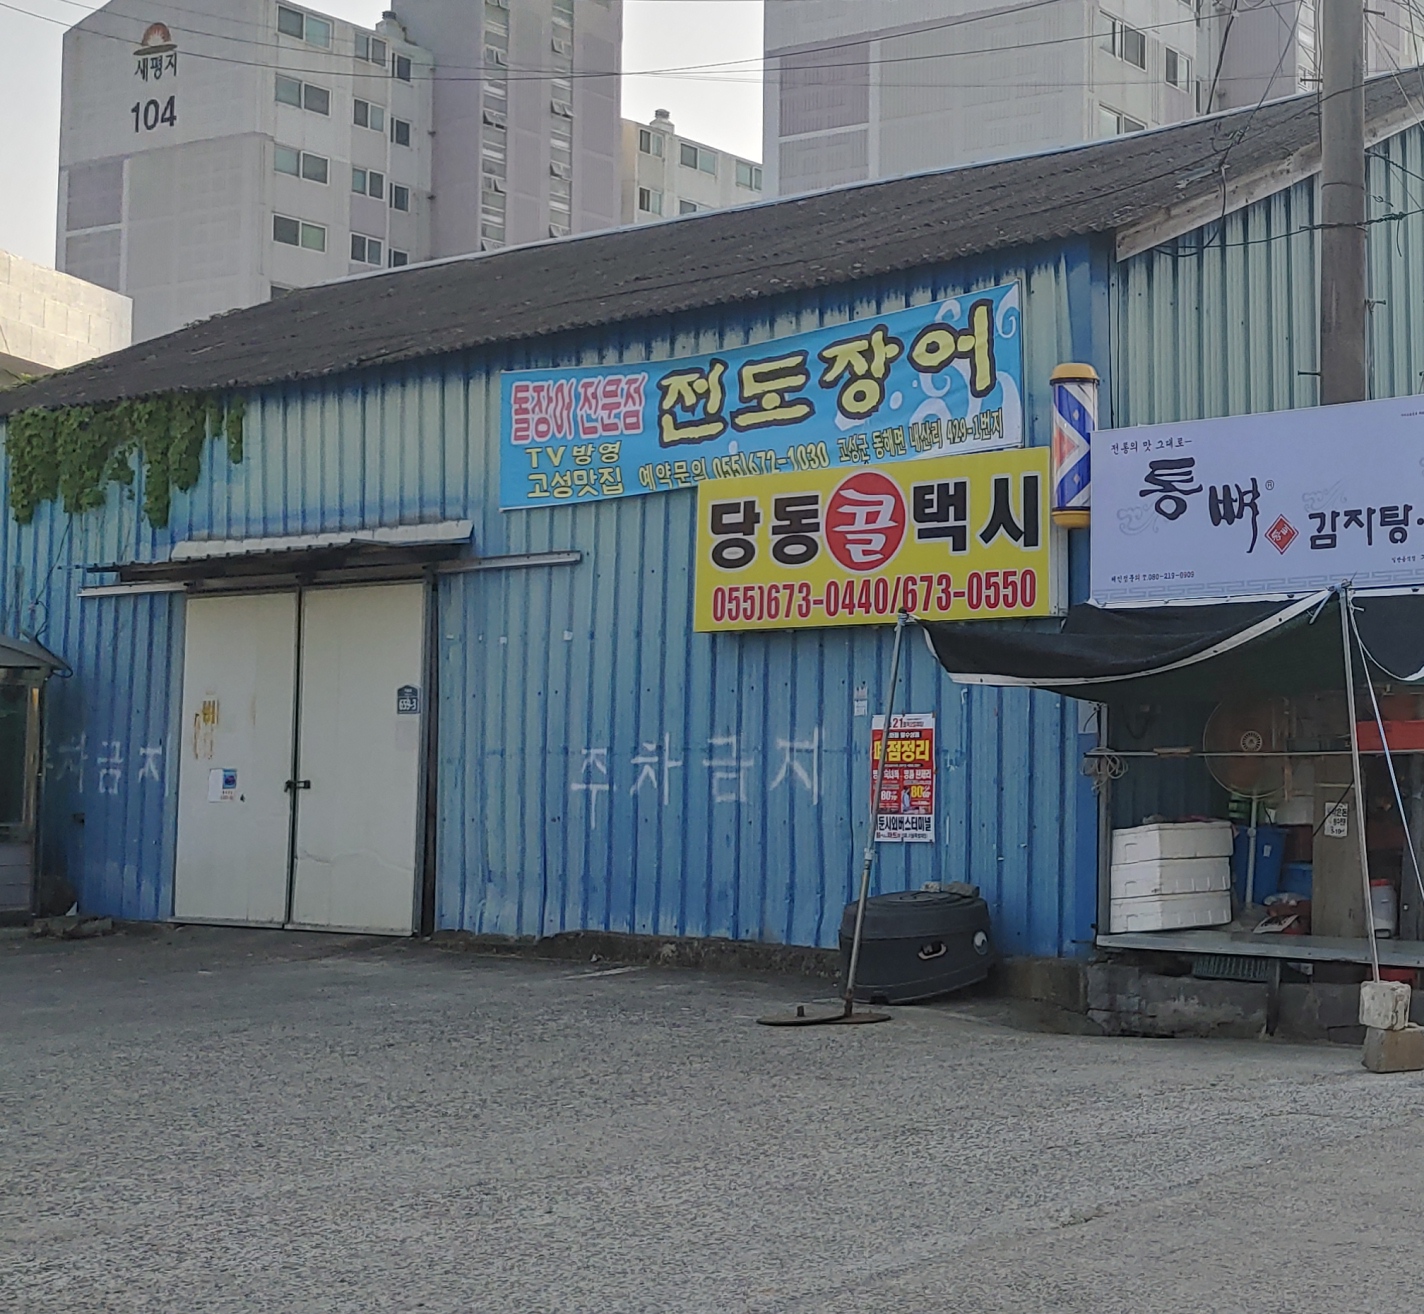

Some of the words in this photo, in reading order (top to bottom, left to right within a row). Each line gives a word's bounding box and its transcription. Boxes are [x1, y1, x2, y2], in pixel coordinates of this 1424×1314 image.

[134, 51, 177, 82] 새평지
[131, 95, 177, 133] 104
[657, 298, 997, 448] 전도장어
[578, 372, 647, 436] 전문점
[525, 446, 566, 468] TV
[572, 440, 621, 465] 방영
[837, 433, 870, 464] 고성군
[872, 425, 906, 459] 동해면
[909, 420, 943, 454] 내산리
[1110, 440, 1138, 455] 전통의
[1143, 439, 1152, 452] 맛
[527, 466, 624, 498] 고성맛집
[638, 459, 707, 491] 예약문의
[713, 568, 1036, 622] 055)673-0440/673-0550
[571, 726, 819, 829] 주차금지
[876, 816, 931, 831] 둔시외버스터미널
